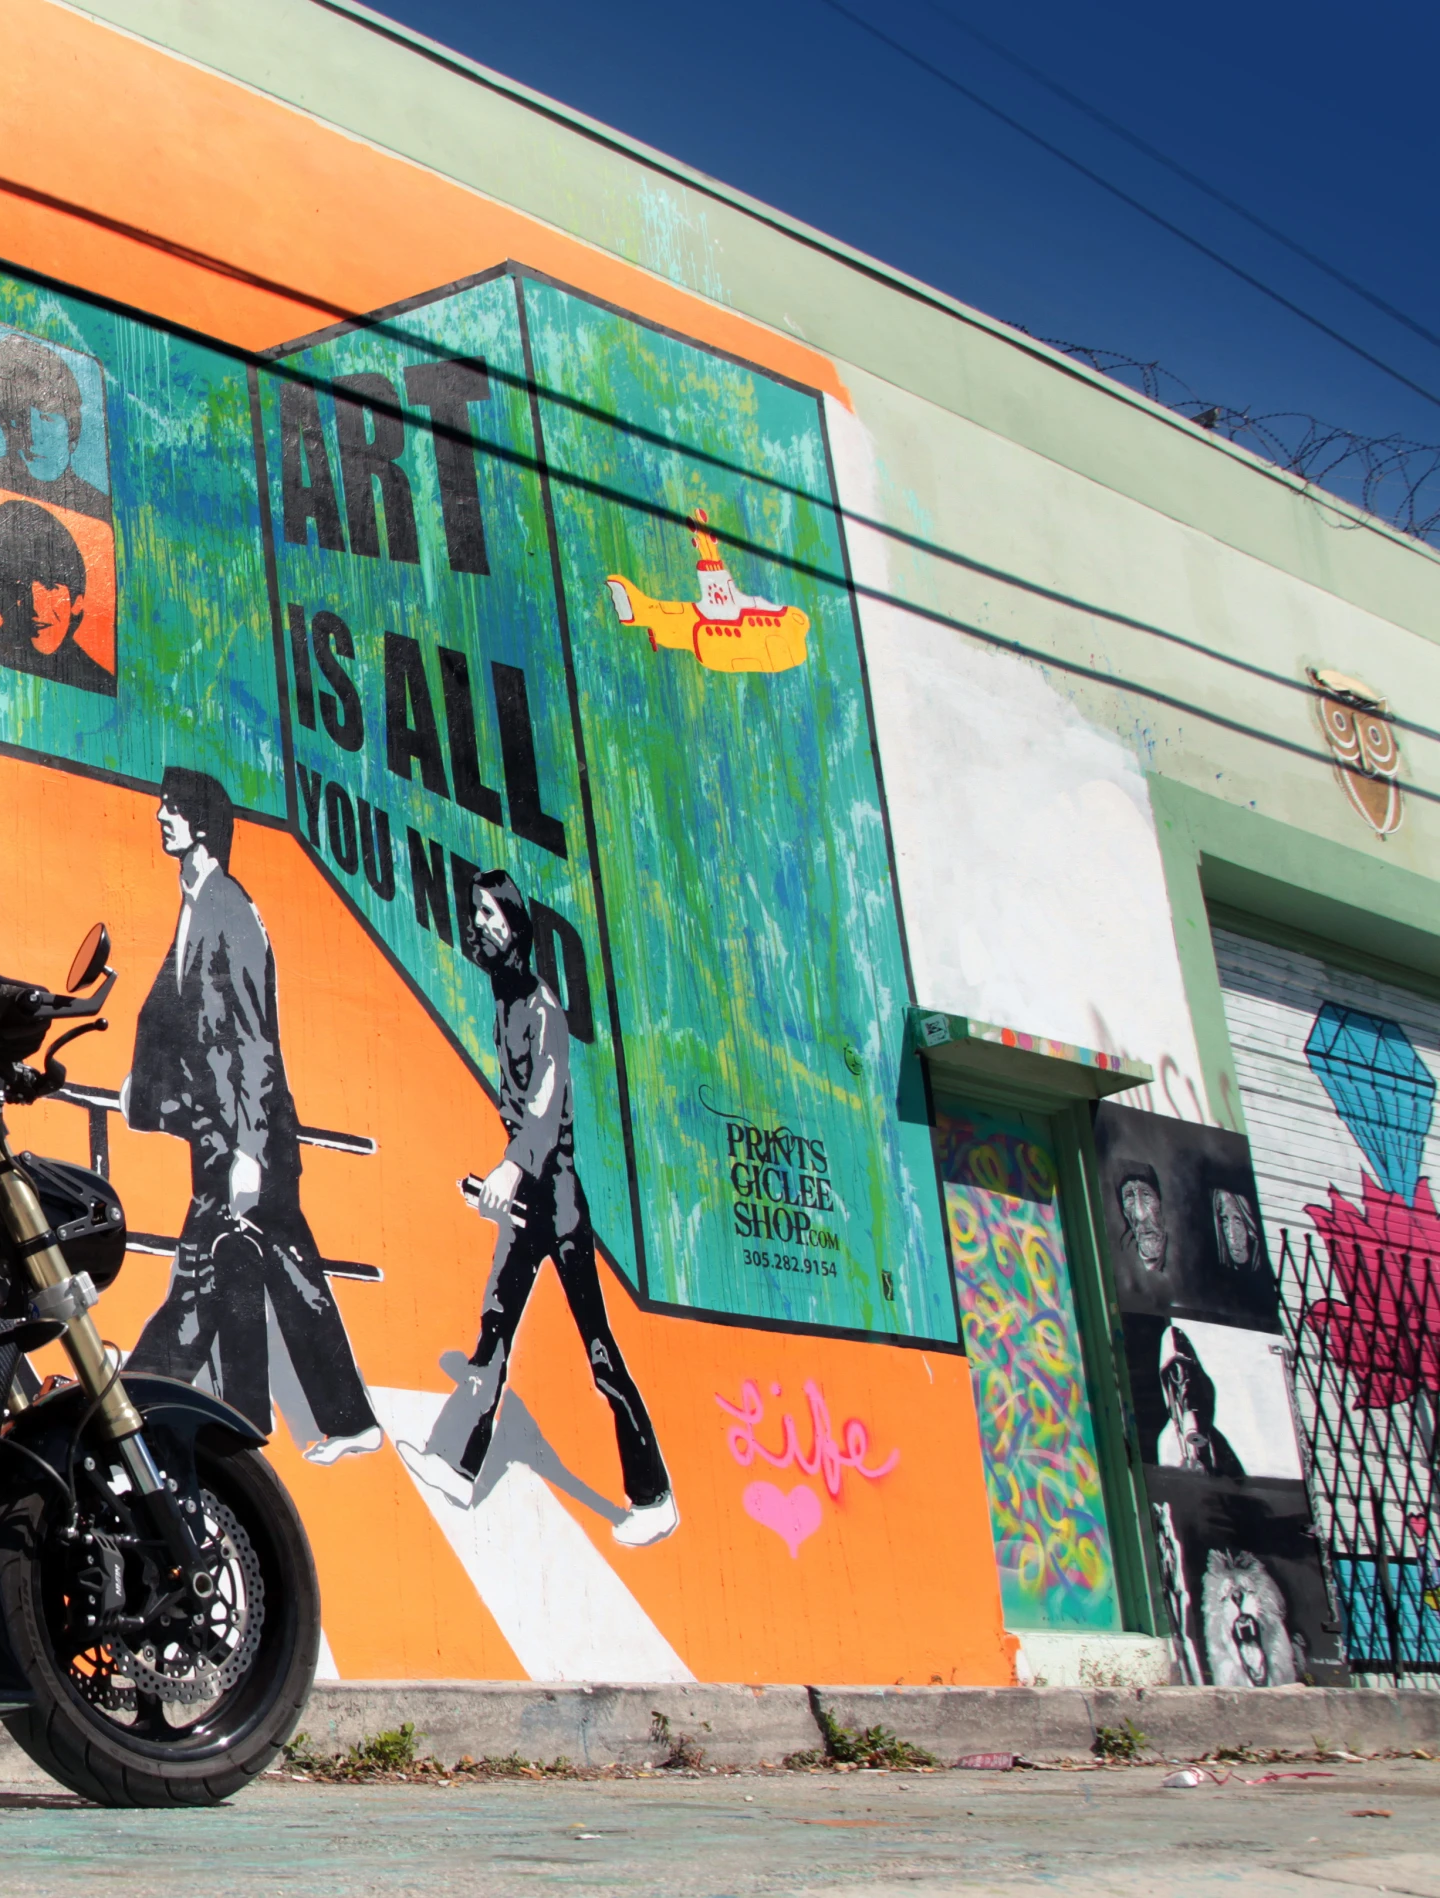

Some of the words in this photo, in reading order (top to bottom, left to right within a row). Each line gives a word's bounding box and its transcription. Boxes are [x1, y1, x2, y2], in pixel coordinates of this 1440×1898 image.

[279, 355, 492, 577] ART
[288, 602, 364, 752] IS
[384, 630, 568, 861] ALL
[296, 762, 396, 902] YOU
[725, 1121, 829, 1174] PRINTS
[730, 1161, 835, 1213] GICLEE
[743, 1249, 838, 1278] 305.282.9154
